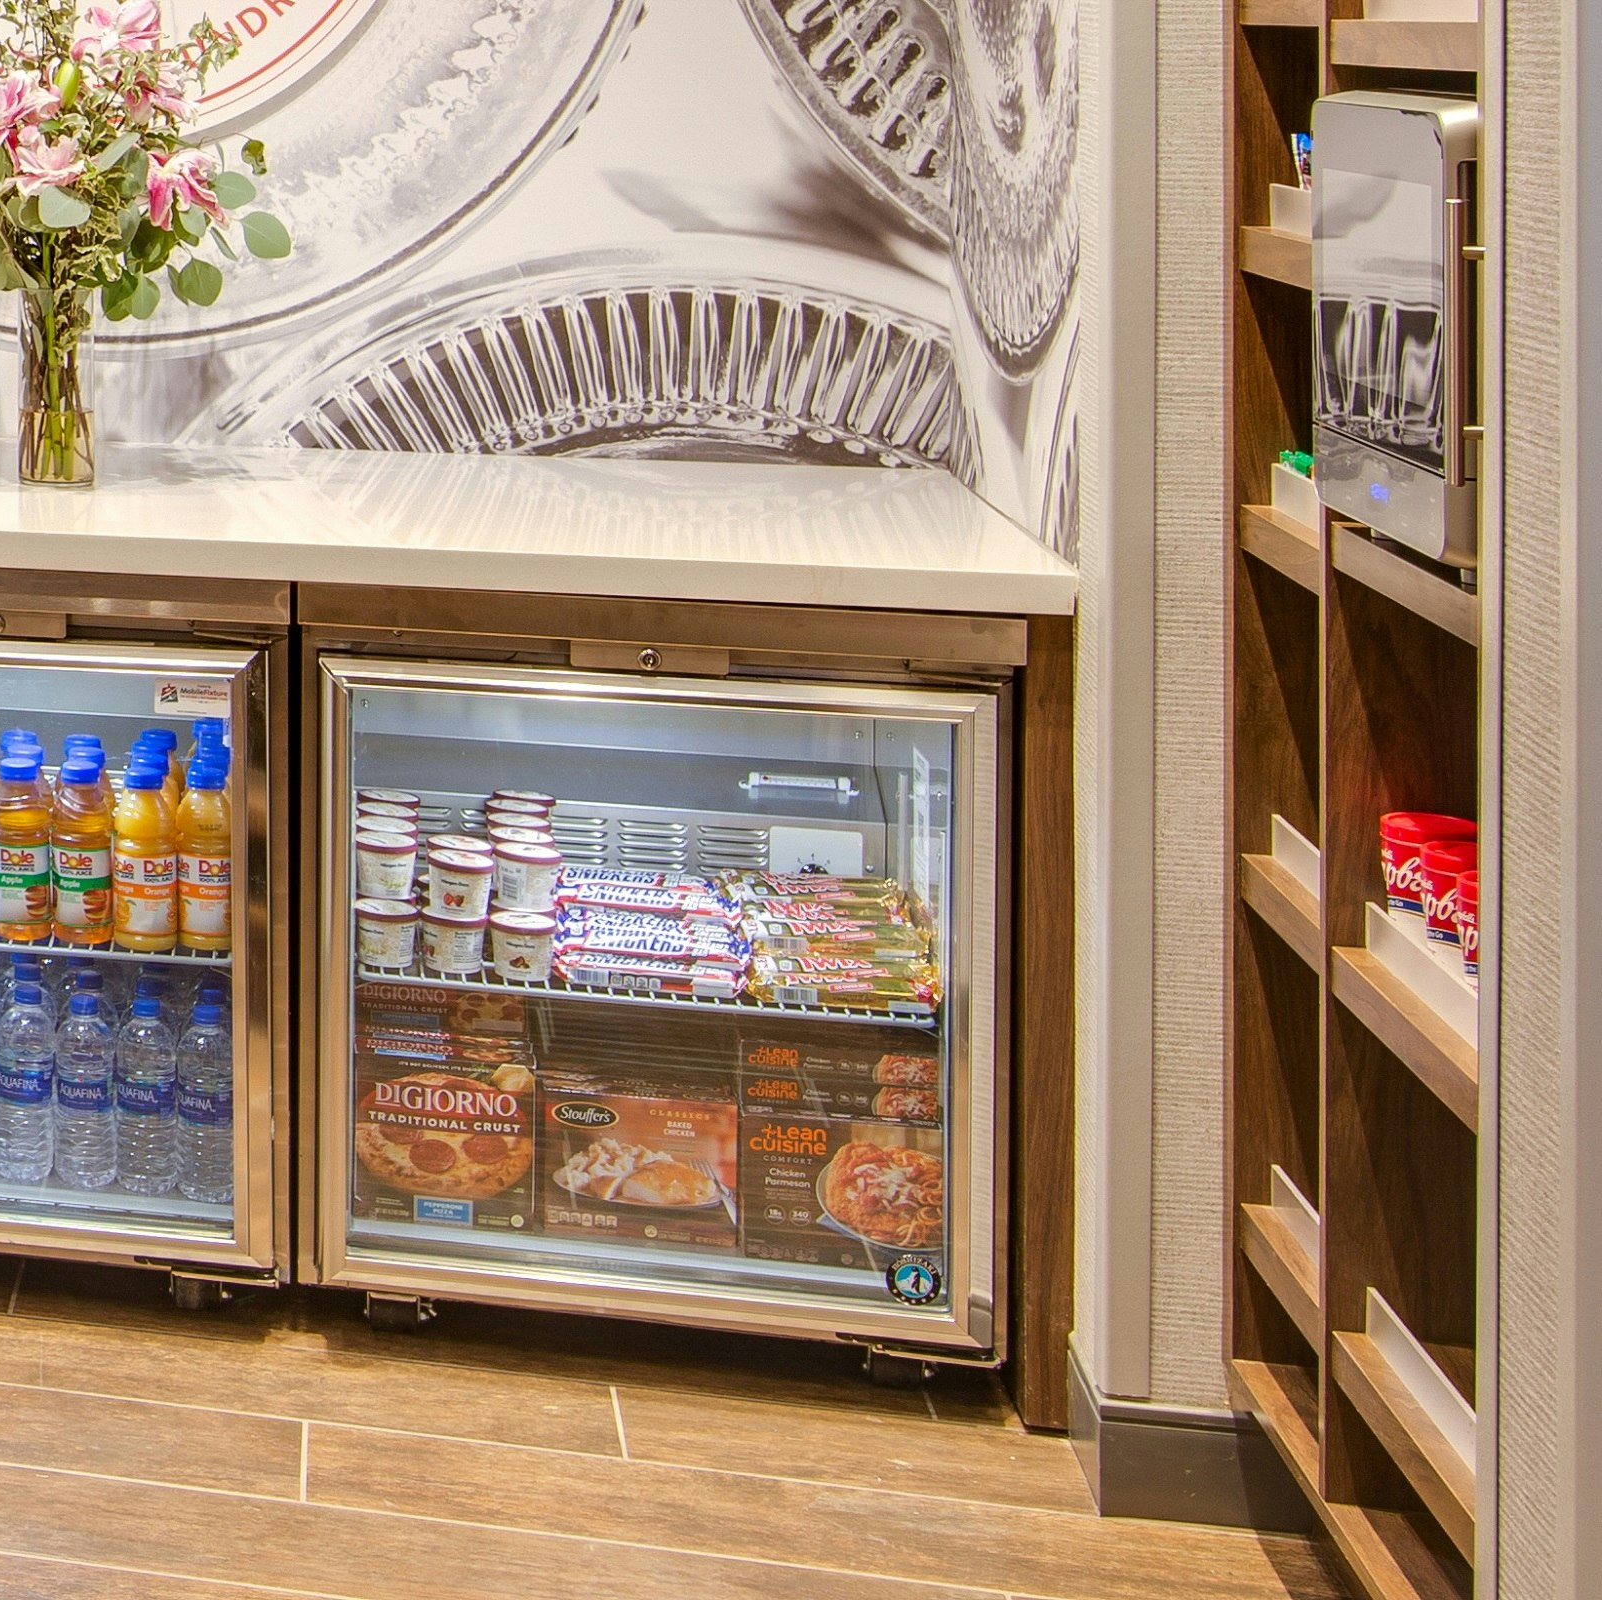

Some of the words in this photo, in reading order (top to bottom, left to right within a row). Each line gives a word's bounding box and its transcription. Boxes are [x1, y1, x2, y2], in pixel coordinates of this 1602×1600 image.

[180, 687, 228, 697] MobileFixture
[0, 850, 35, 865] Dole
[59, 851, 93, 868] Dole
[143, 859, 174, 876] Dole
[198, 859, 231, 876] Dole
[0, 875, 24, 885] Apple
[59, 878, 81, 889] Apple
[144, 887, 171, 897] Orange
[198, 887, 228, 897] Orange
[363, 985, 447, 1004] DIGIORNO
[361, 1002, 419, 1012] TRADITIONAL
[421, 1006, 449, 1014] CRUST
[765, 1047, 799, 1058] Lean
[805, 1056, 831, 1064] Chicken
[764, 1080, 798, 1091] Lean
[375, 1082, 519, 1118] DIGIORNO
[559, 1105, 612, 1124] Stouffer's
[368, 1110, 468, 1131] TRADITIONAL
[473, 1121, 521, 1134] CRUST
[666, 1120, 693, 1129] BAKED
[663, 1128, 696, 1137] CHICKEN
[775, 1126, 827, 1142] Lean
[763, 1154, 813, 1166] COMFORT
[769, 1167, 807, 1179] Chicken
[764, 1176, 811, 1189] Parmesan
